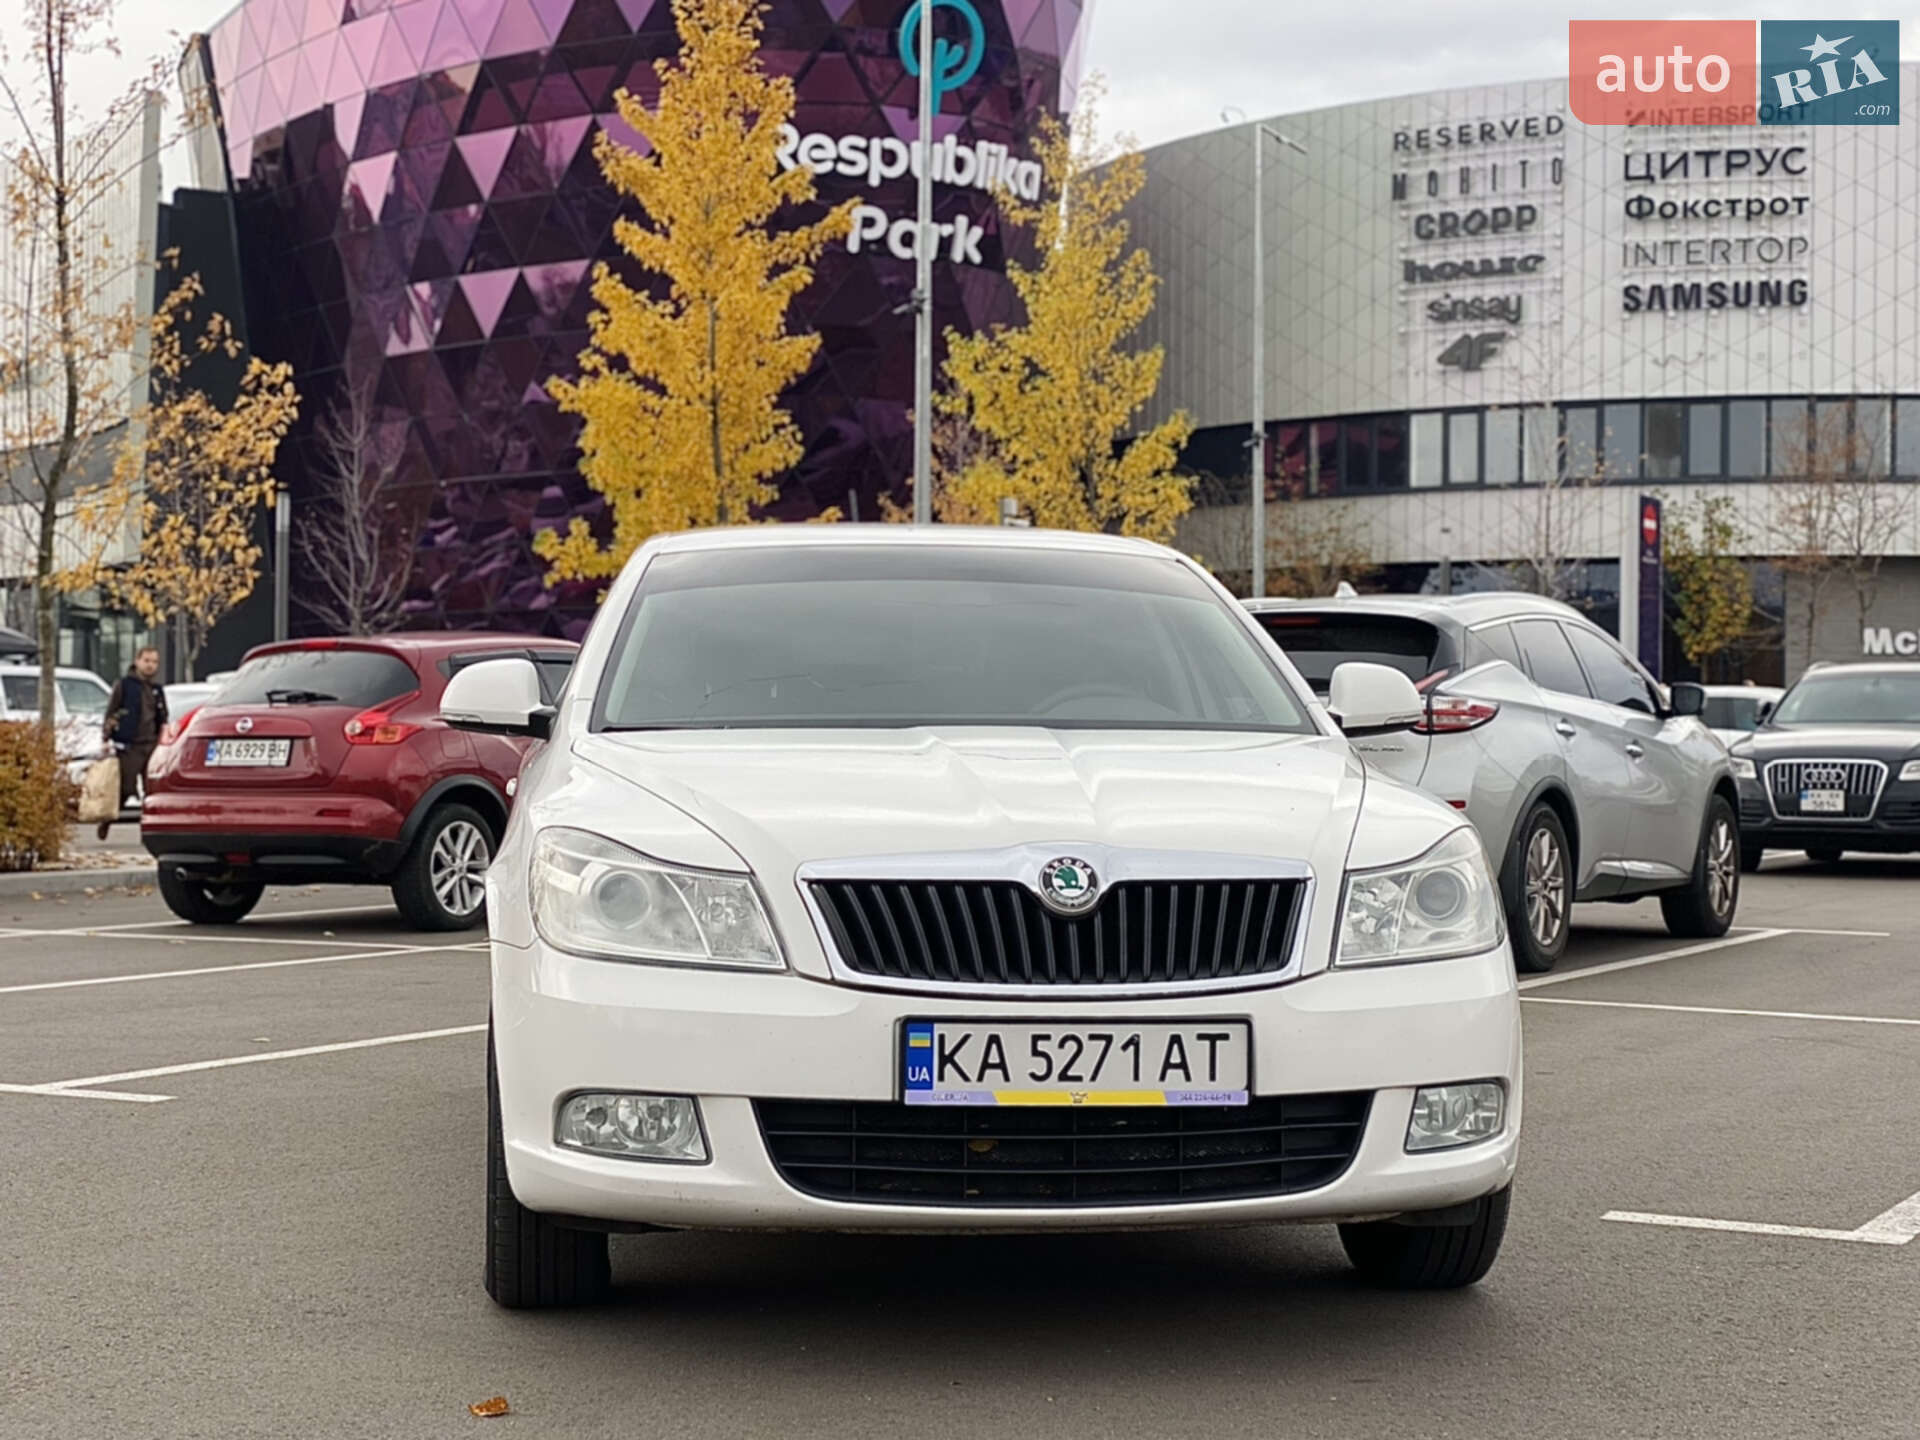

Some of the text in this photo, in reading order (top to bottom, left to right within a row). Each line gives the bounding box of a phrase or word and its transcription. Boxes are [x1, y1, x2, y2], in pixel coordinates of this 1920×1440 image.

[1394, 115, 1564, 152] RESERVED
[775, 122, 1042, 200] Respublika
[1625, 147, 1807, 183] ЦИТРУС
[1415, 204, 1537, 240] CROPP
[1625, 195, 1809, 222] Фокстрот
[846, 205, 984, 264] Park
[1623, 237, 1808, 267] INTERTOP
[1427, 294, 1522, 324] sinsay
[1623, 279, 1808, 313] SAMSUNG
[1436, 331, 1506, 372] 4F
[1863, 628, 1920, 654] Mc
[908, 1066, 931, 1082] UA
[937, 1032, 1230, 1082] KA 5271 AT
